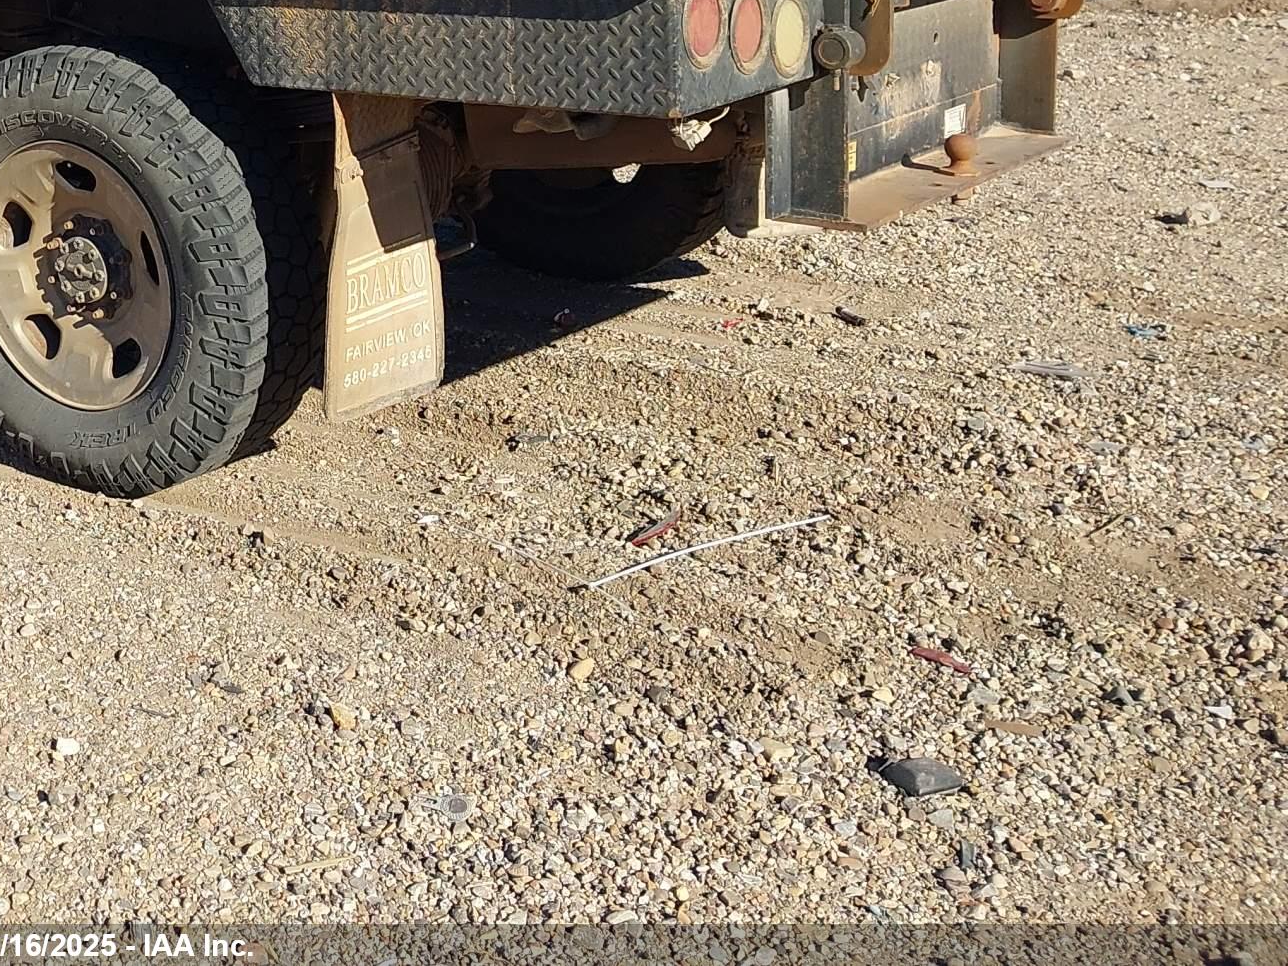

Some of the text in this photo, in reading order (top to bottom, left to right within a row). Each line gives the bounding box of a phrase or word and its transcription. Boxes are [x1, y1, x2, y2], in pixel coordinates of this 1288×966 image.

[345, 252, 426, 315] BRAMCO
[344, 319, 432, 363] FAIRVIEW, OK
